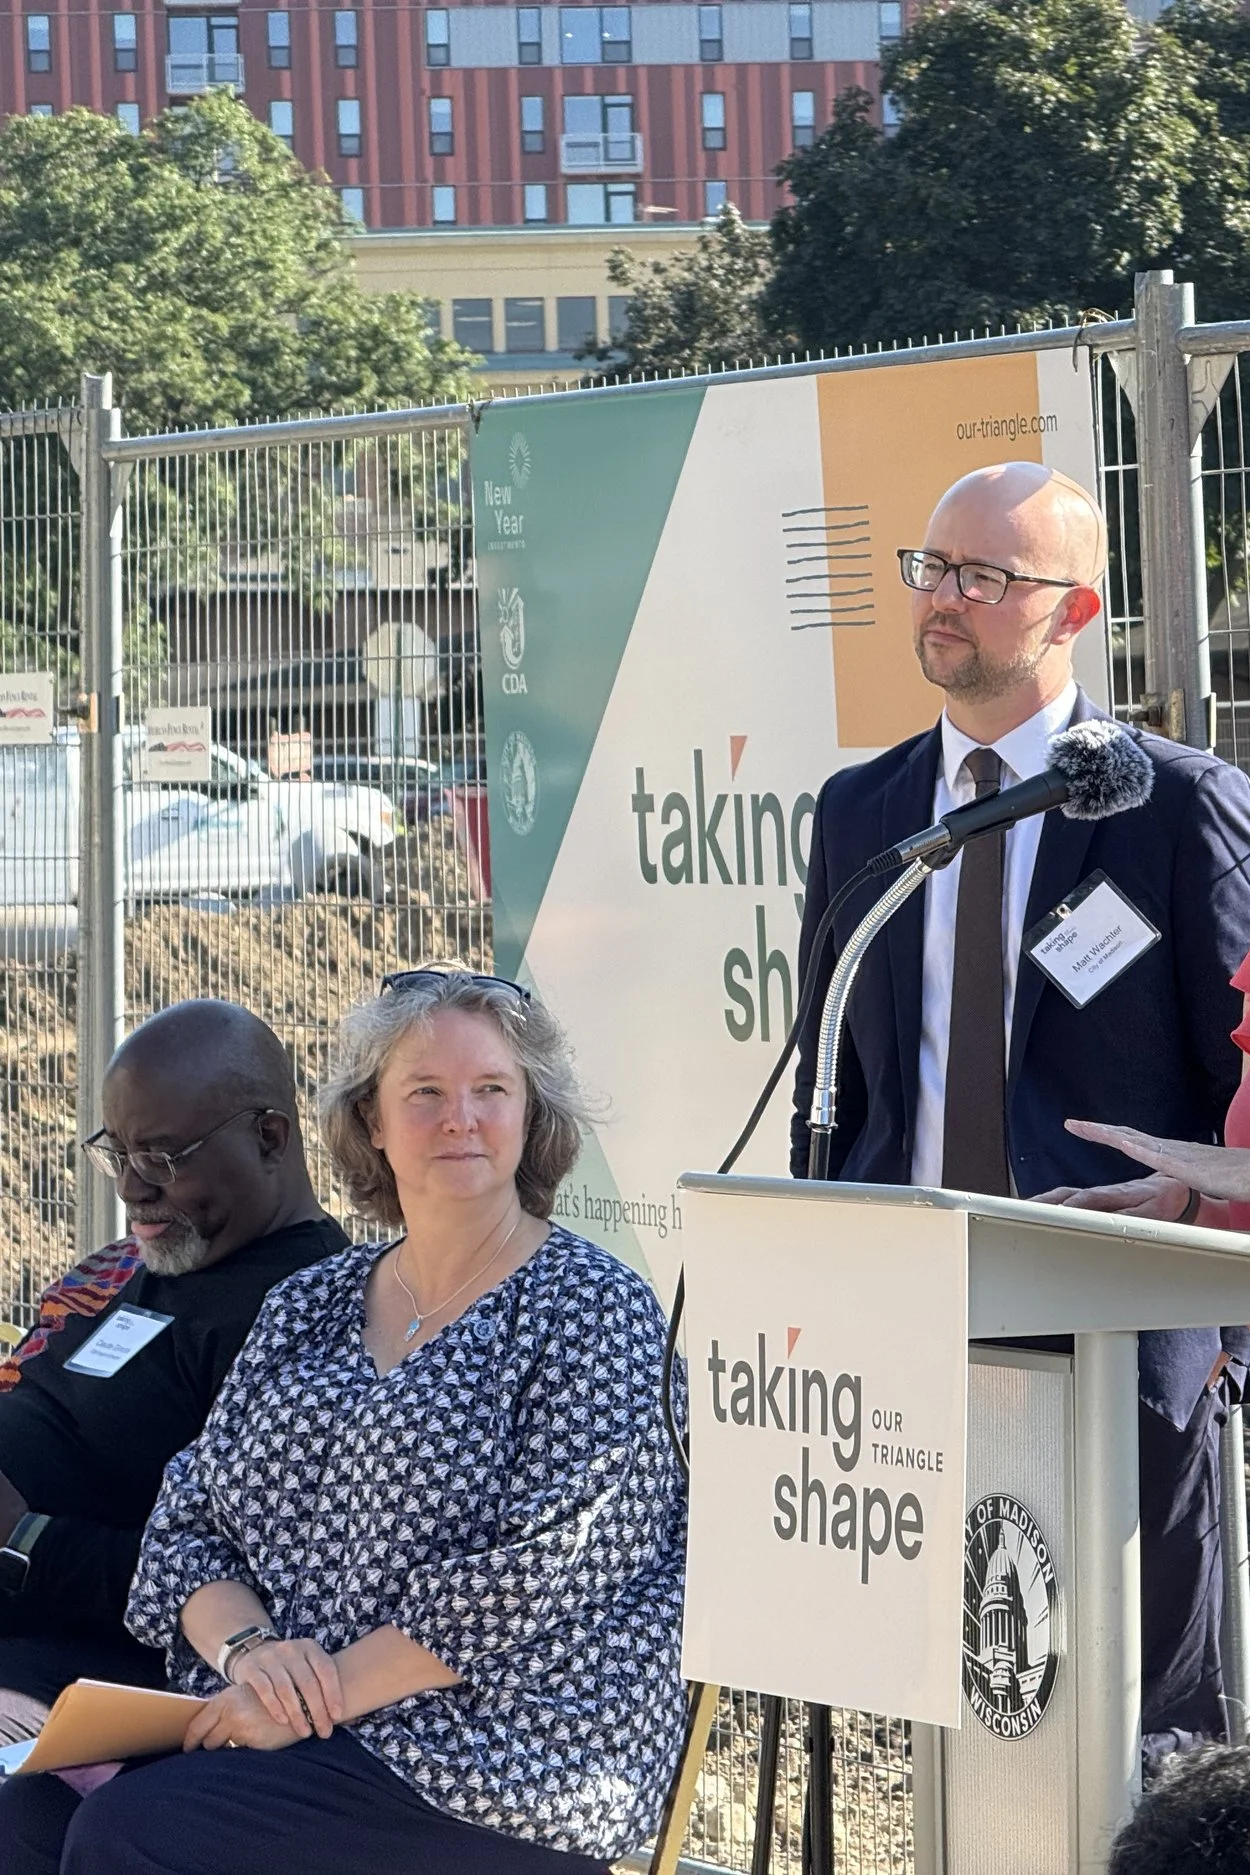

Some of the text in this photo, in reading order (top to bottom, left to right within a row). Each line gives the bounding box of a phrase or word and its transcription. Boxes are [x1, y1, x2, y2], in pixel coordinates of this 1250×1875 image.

[956, 412, 1058, 441] our-triangle.com
[484, 480, 512, 506] New
[494, 509, 524, 535] Year
[502, 673, 528, 694] CDA
[1040, 930, 1065, 955] taking
[1055, 931, 1078, 953] shape
[1072, 924, 1123, 973] Matt Wachter
[553, 1182, 580, 1218] at's
[583, 1184, 668, 1239] happening
[708, 1326, 863, 1473] taking
[871, 1408, 903, 1433] OUR
[871, 1442, 944, 1473] TRIANGLE
[773, 1446, 924, 1585] shape
[976, 1499, 993, 1524] OF
[999, 1497, 1054, 1584] MADISON
[970, 1686, 1042, 1737] WISCONSIN
